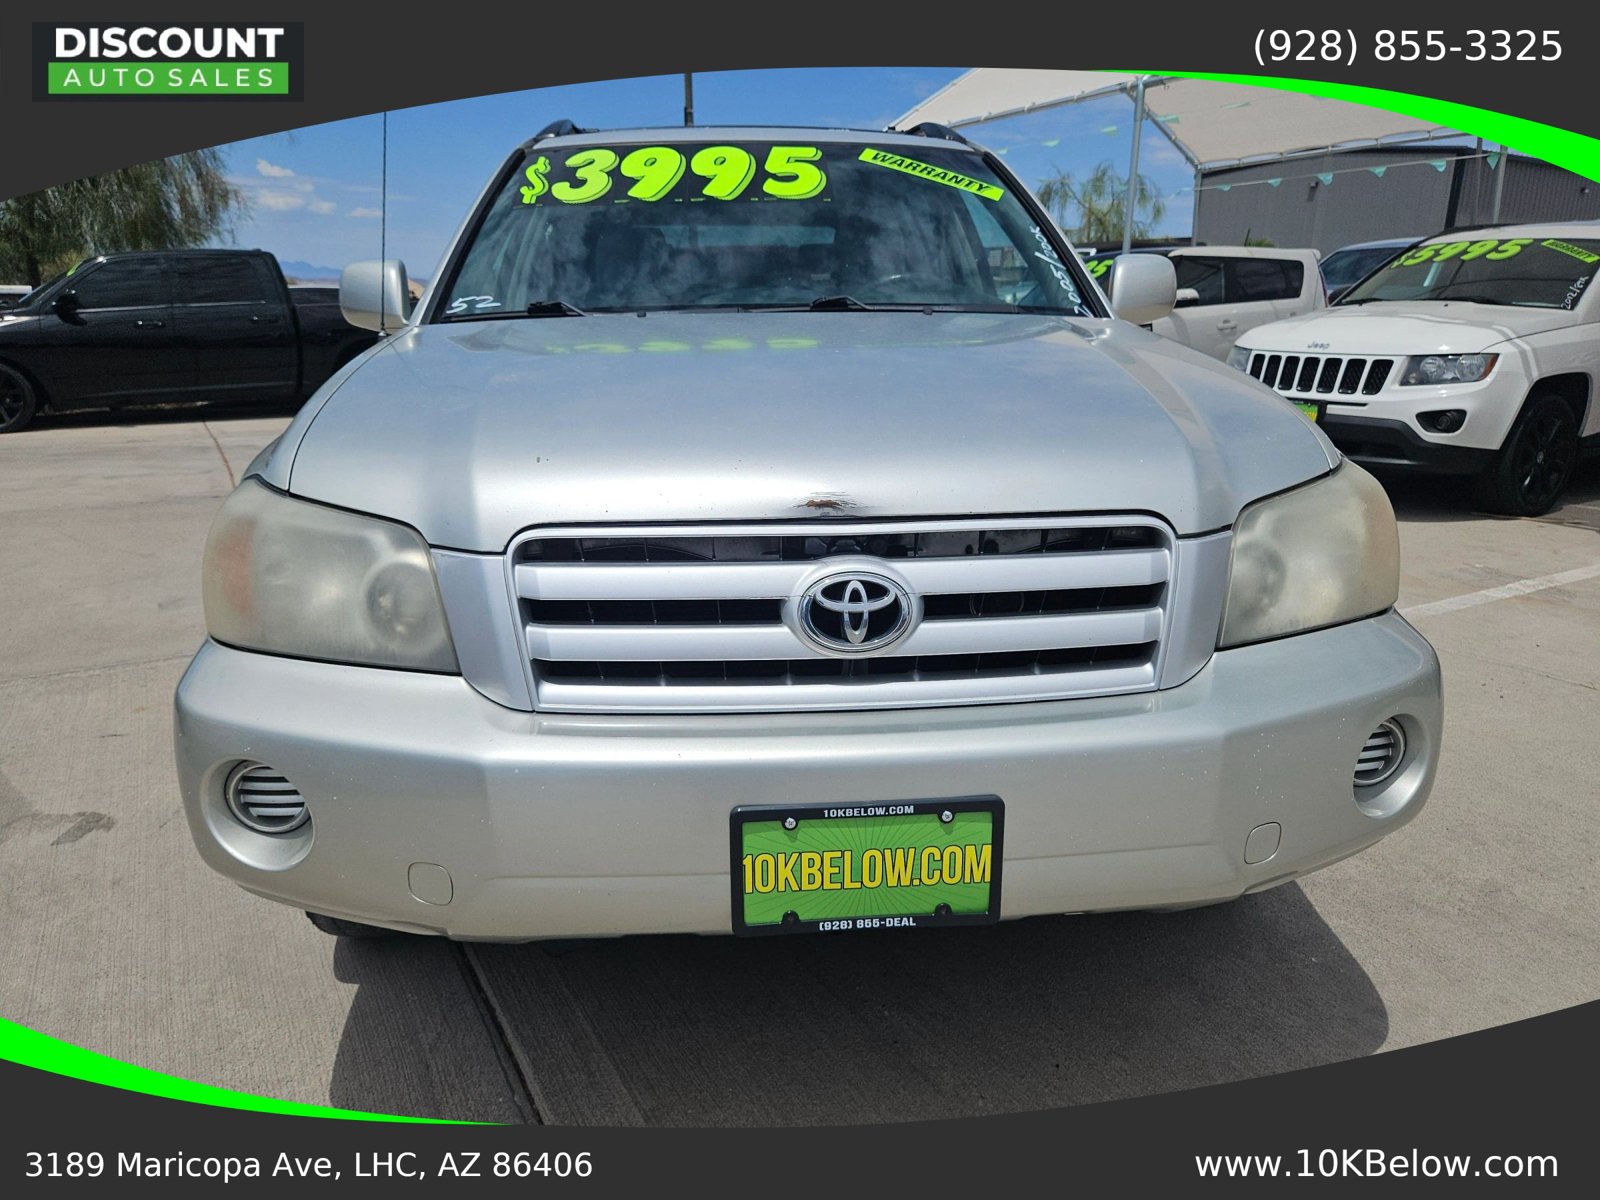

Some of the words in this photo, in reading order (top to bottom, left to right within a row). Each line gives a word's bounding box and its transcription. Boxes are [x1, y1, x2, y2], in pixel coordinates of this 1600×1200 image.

[519, 146, 828, 204] $3995
[871, 152, 991, 192] WARRANTY
[446, 295, 501, 314] 52
[823, 805, 915, 818] 10KBELOW.COM
[742, 844, 992, 894] 10KBELOW.COM
[819, 920, 853, 931] (928)
[856, 916, 916, 929] 855-DEAL
